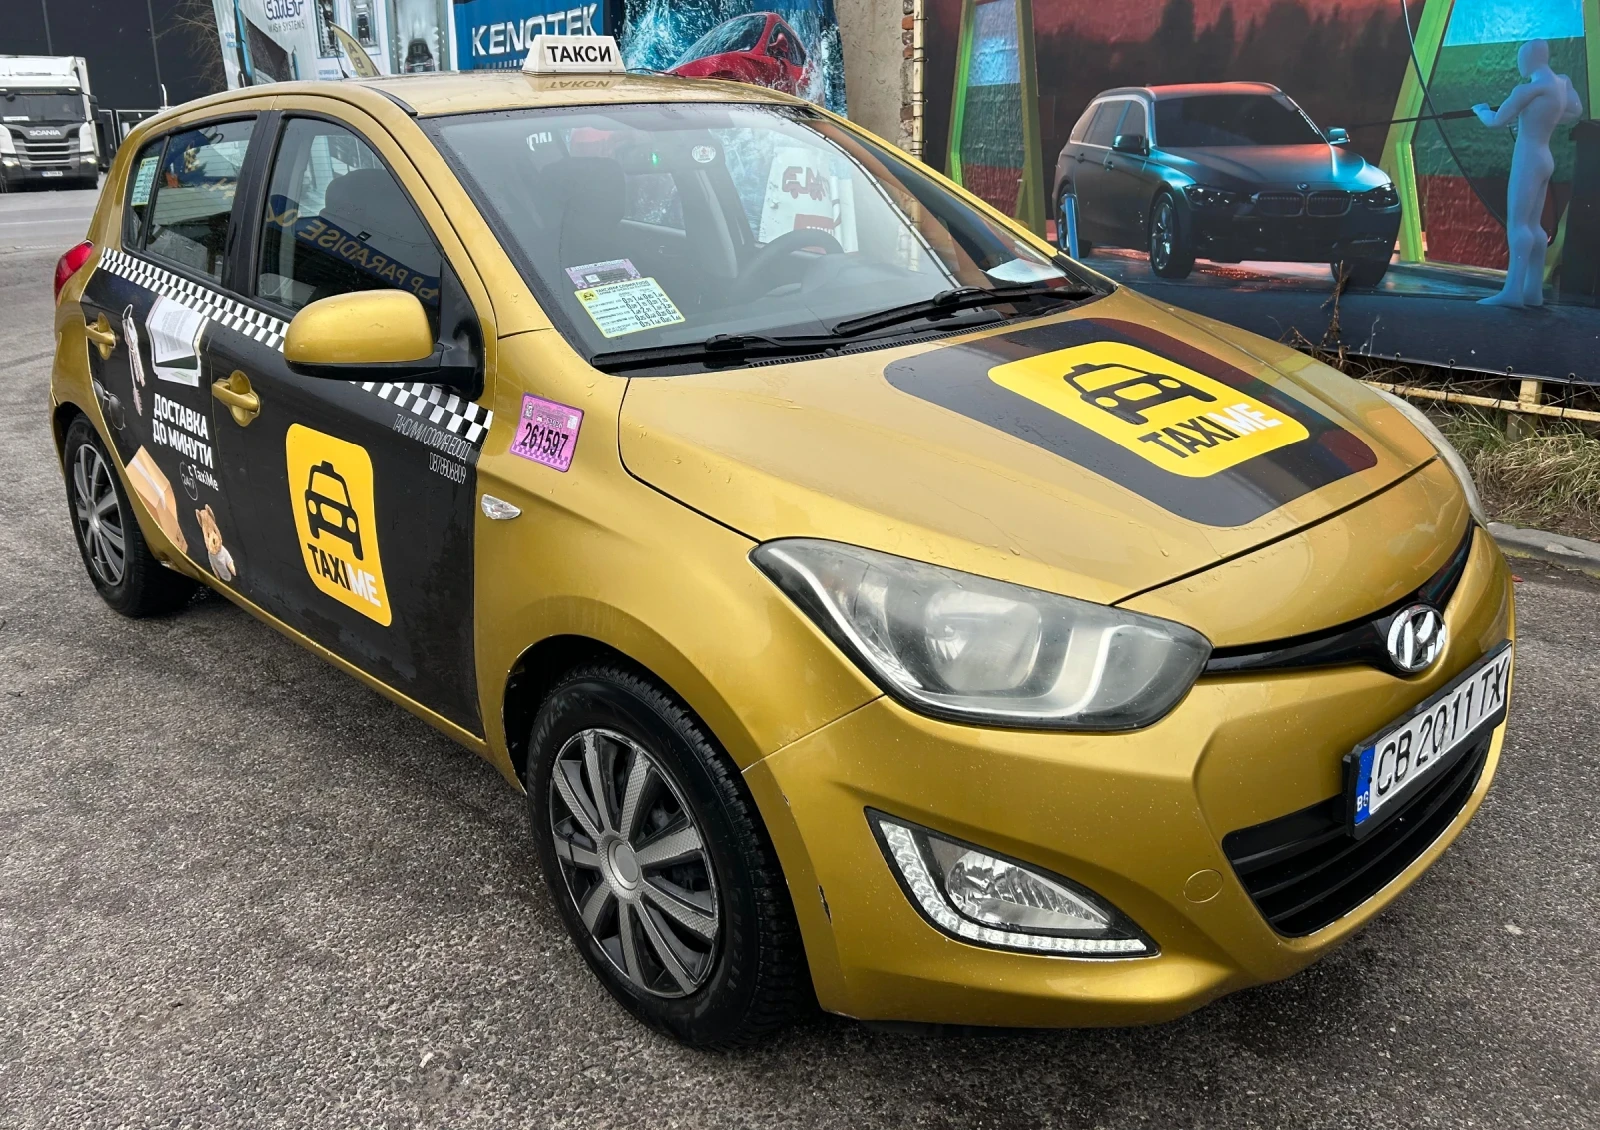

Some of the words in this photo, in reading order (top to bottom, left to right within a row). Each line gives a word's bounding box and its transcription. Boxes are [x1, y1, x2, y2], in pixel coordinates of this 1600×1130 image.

[282, 20, 305, 32] SYSTEMS
[471, 3, 597, 57] KENOTEK
[546, 44, 612, 63] ТАКСИ
[154, 393, 209, 440] ДОСТАВКА
[153, 418, 168, 444] ДО
[169, 433, 213, 469] МИНУТИ
[521, 422, 569, 459] 261597
[191, 463, 219, 491] TaxiMe
[1376, 729, 1413, 797] CB
[1415, 681, 1474, 767] 2011
[1480, 655, 1509, 717] TX
[1356, 790, 1370, 812] BG
